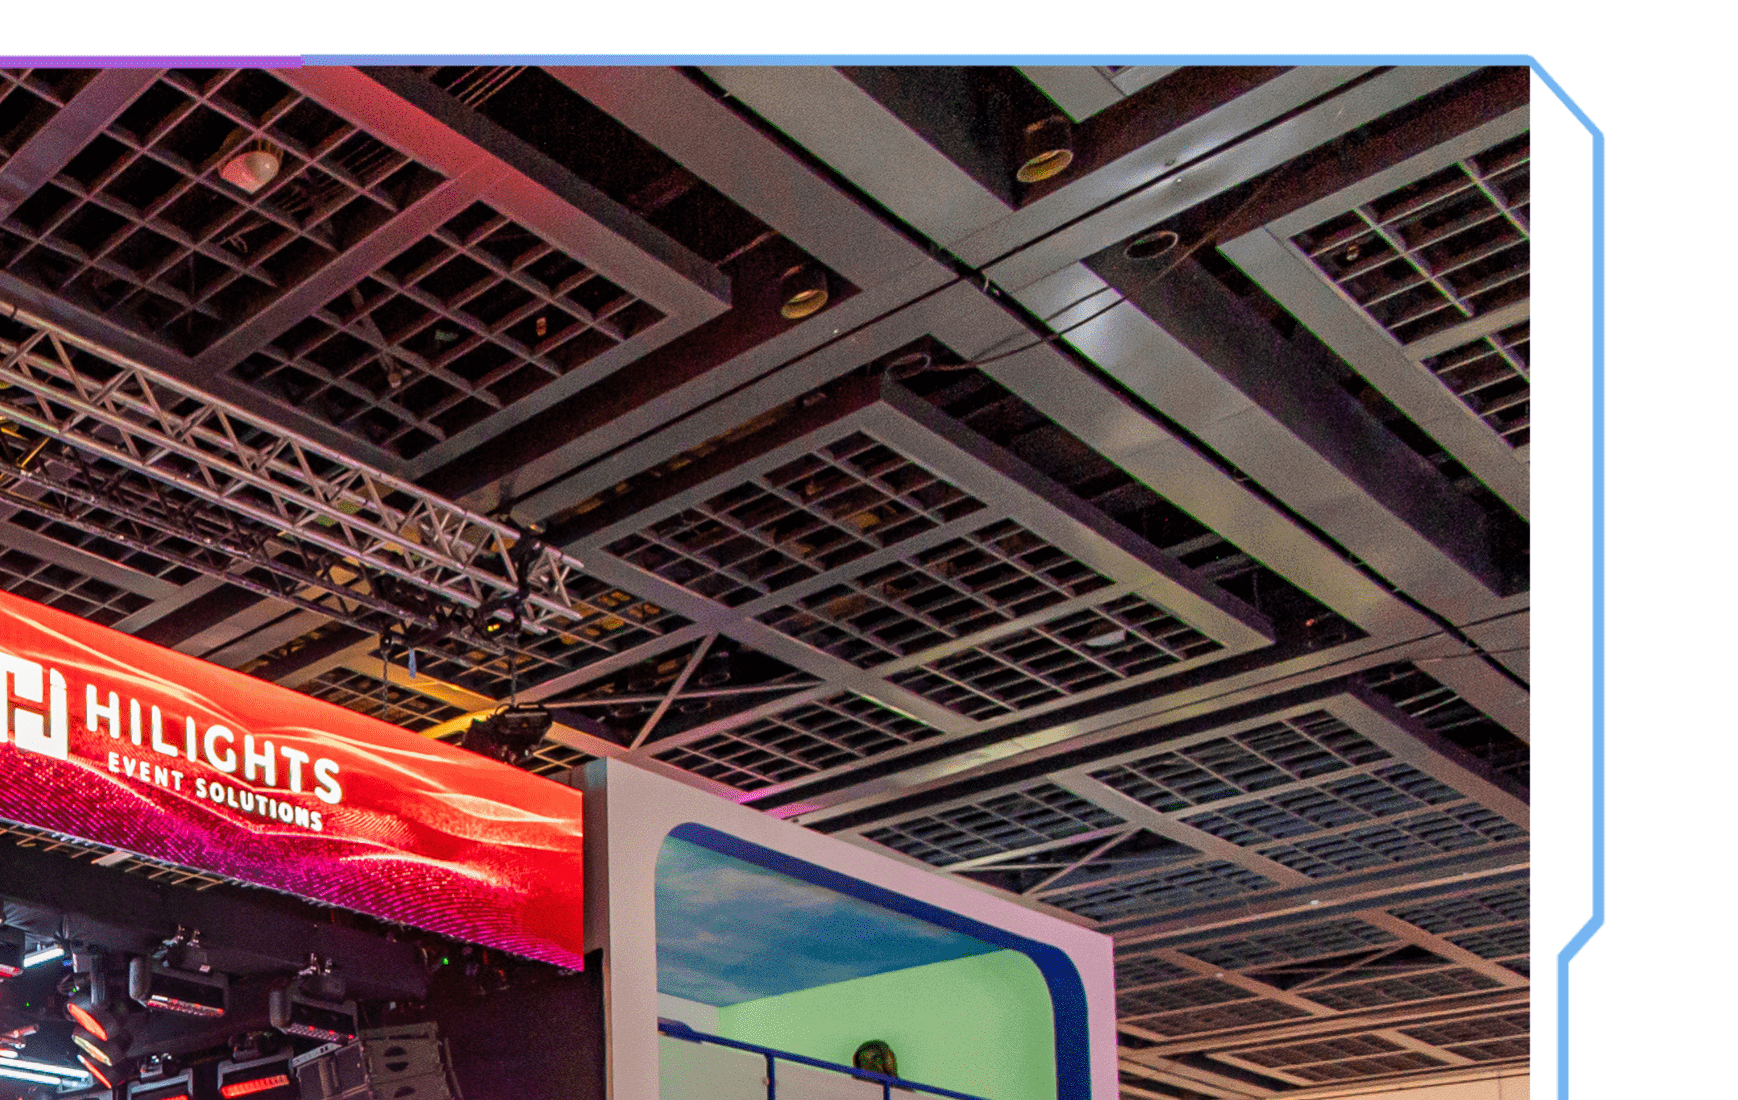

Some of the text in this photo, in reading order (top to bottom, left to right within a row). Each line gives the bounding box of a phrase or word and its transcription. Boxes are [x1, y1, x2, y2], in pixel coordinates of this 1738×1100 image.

[86, 684, 343, 805] HILIGHTS
[108, 752, 323, 832] EVENT SOLUTIONS
